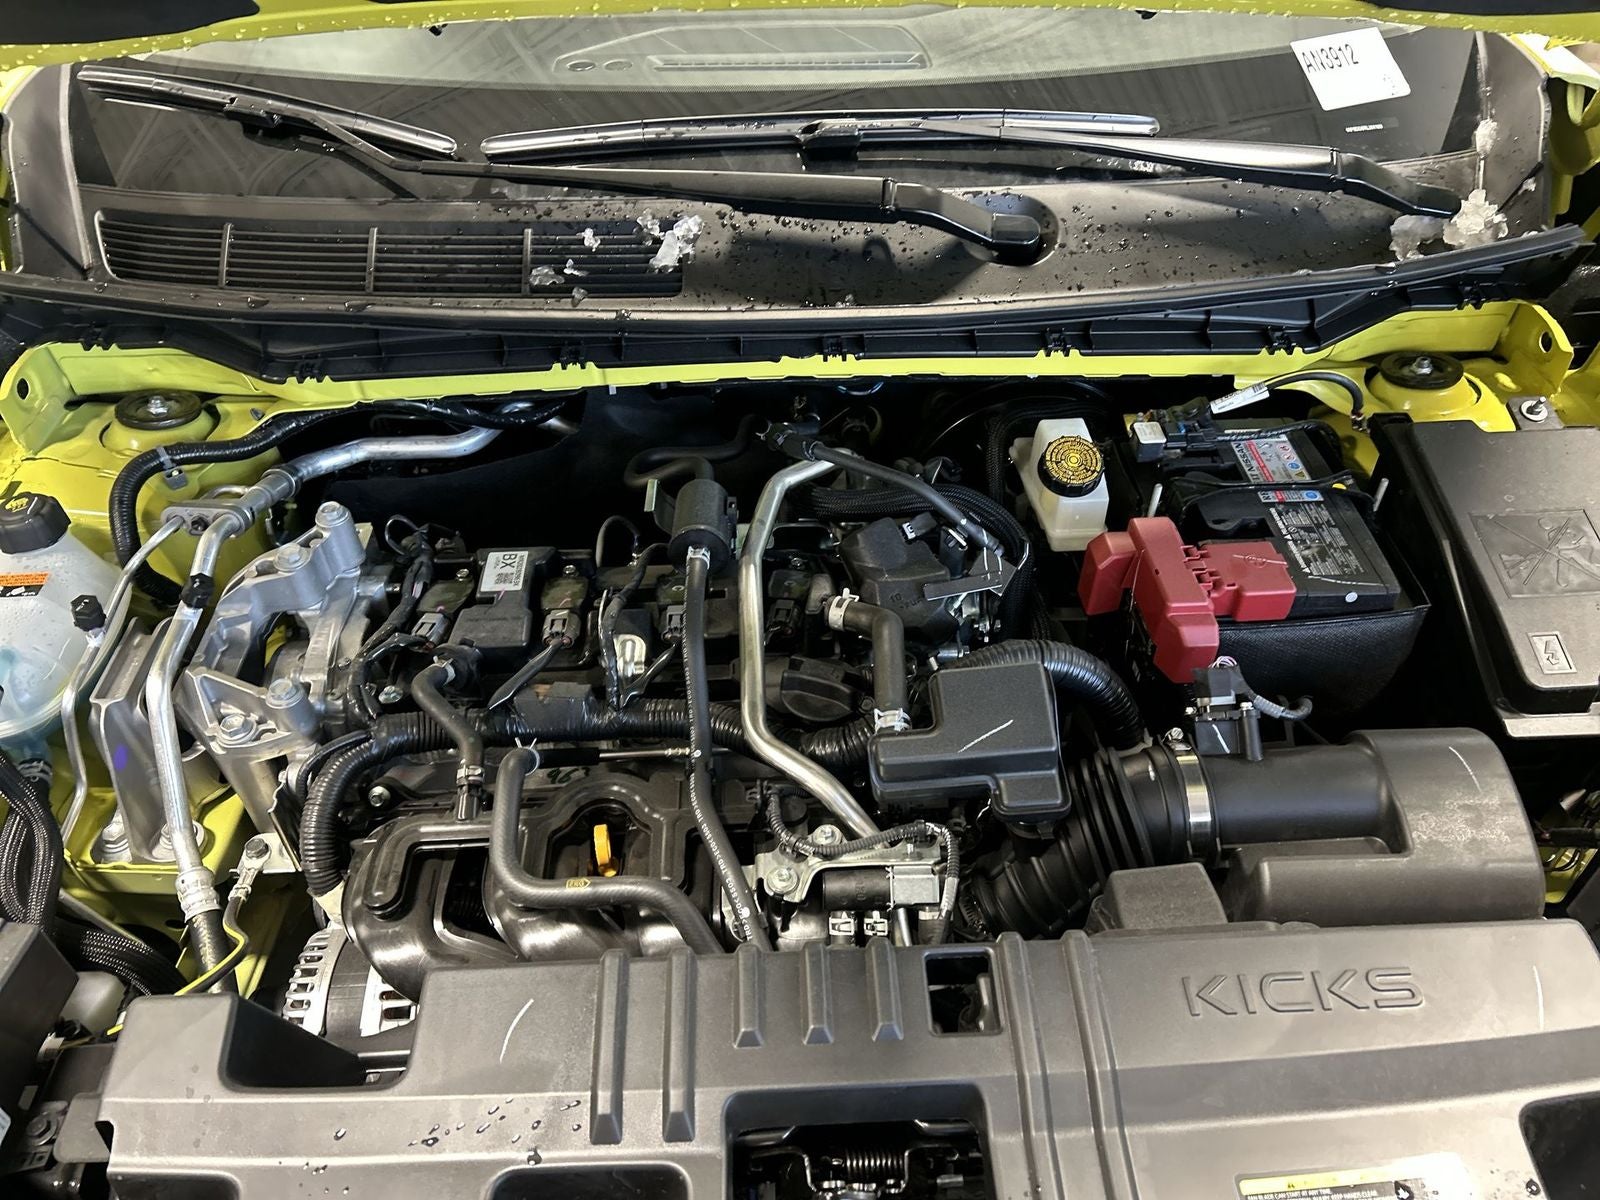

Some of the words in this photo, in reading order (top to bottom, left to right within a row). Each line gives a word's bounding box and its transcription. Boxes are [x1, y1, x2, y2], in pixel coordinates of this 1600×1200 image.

[1301, 43, 1359, 74] AN3912
[500, 553, 518, 570] BX
[1182, 967, 1424, 1017] KICKS
